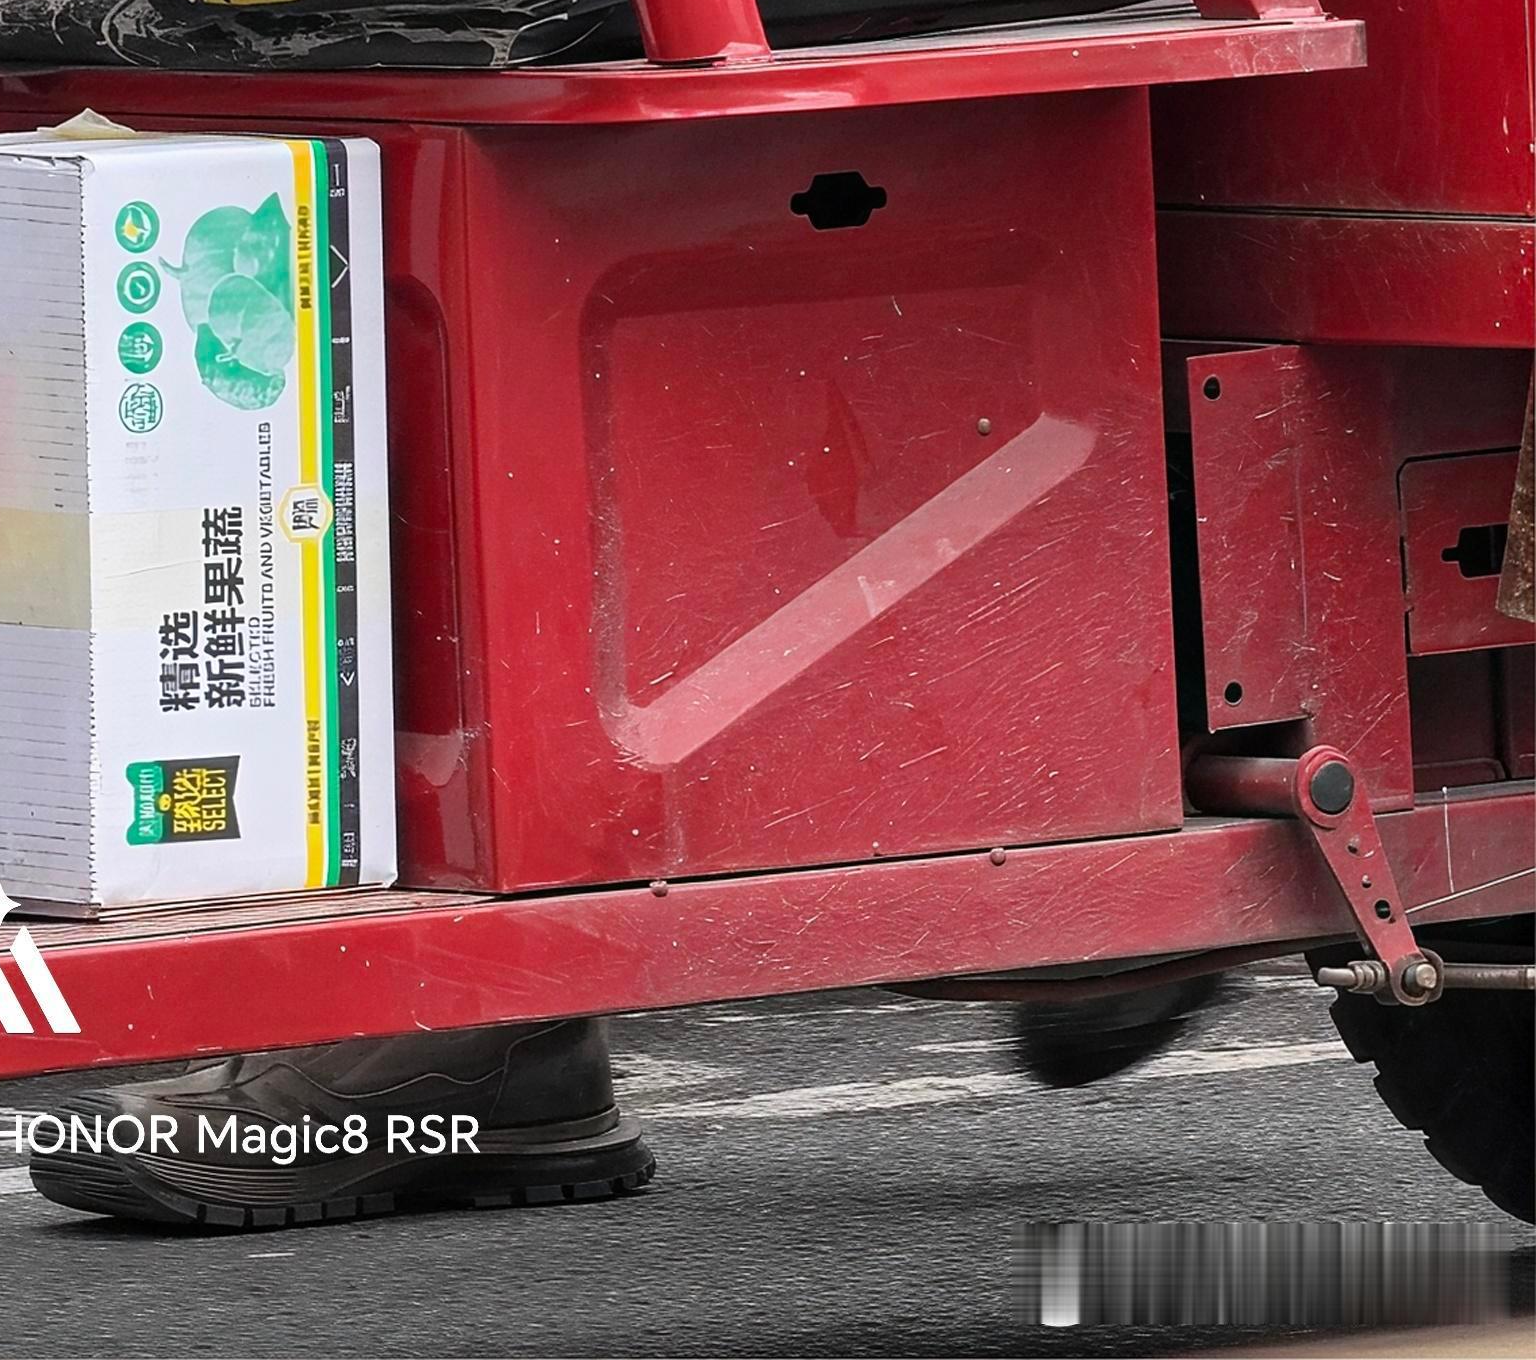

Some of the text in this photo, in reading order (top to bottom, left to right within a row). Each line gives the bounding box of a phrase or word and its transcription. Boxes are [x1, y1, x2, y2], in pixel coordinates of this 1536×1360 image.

[260, 542, 274, 580] AND
[202, 506, 247, 709] 新鲜果蔬
[160, 610, 200, 712] 精选
[201, 768, 227, 832] SELECT
